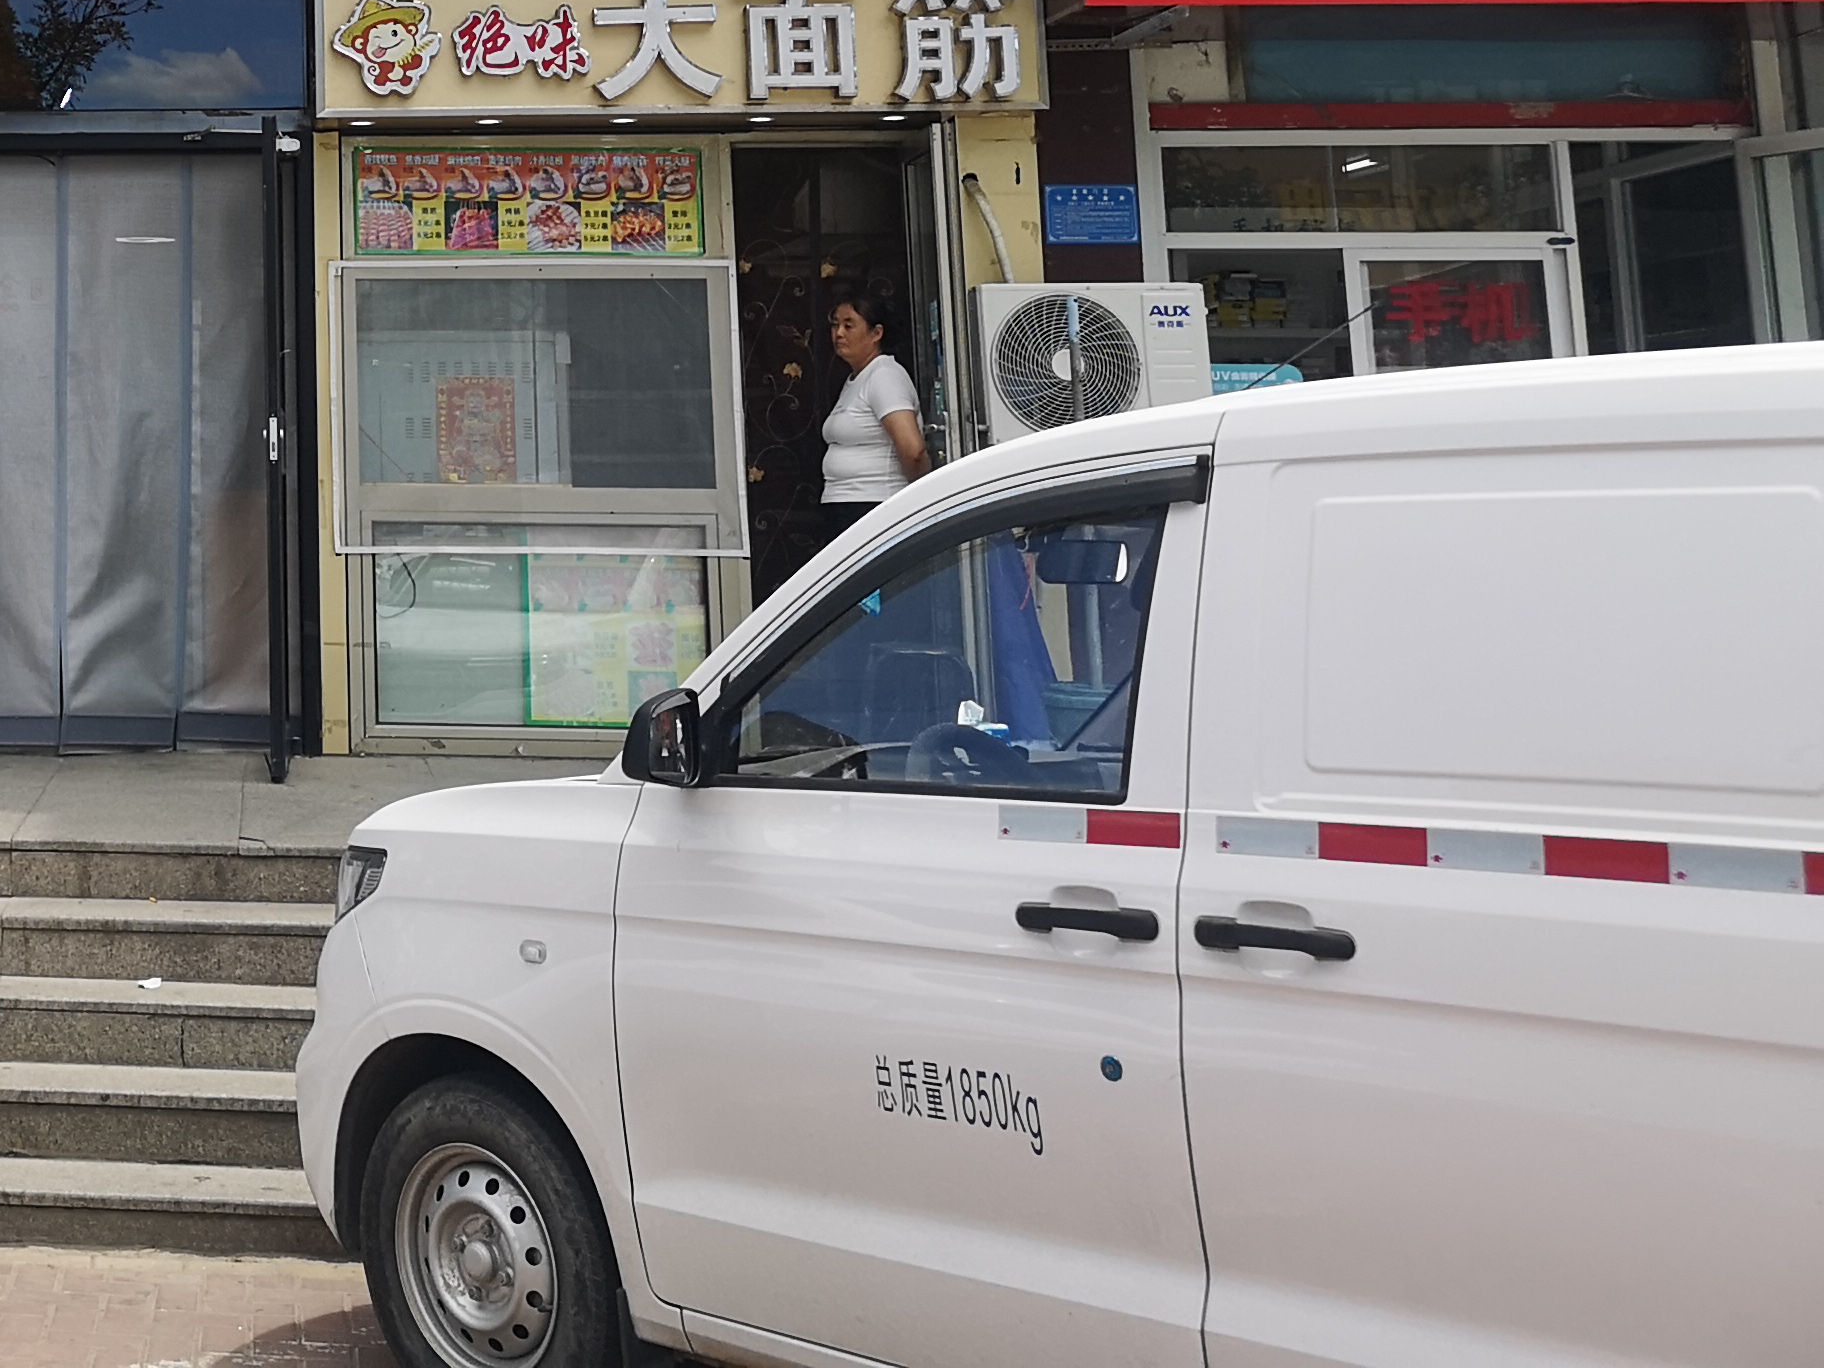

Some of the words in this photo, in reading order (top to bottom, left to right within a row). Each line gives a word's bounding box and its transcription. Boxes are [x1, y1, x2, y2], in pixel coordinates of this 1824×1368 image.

[452, 3, 592, 82] 绝味
[1149, 305, 1191, 317] AUX
[875, 1054, 1044, 1156] 总质量1850kg
